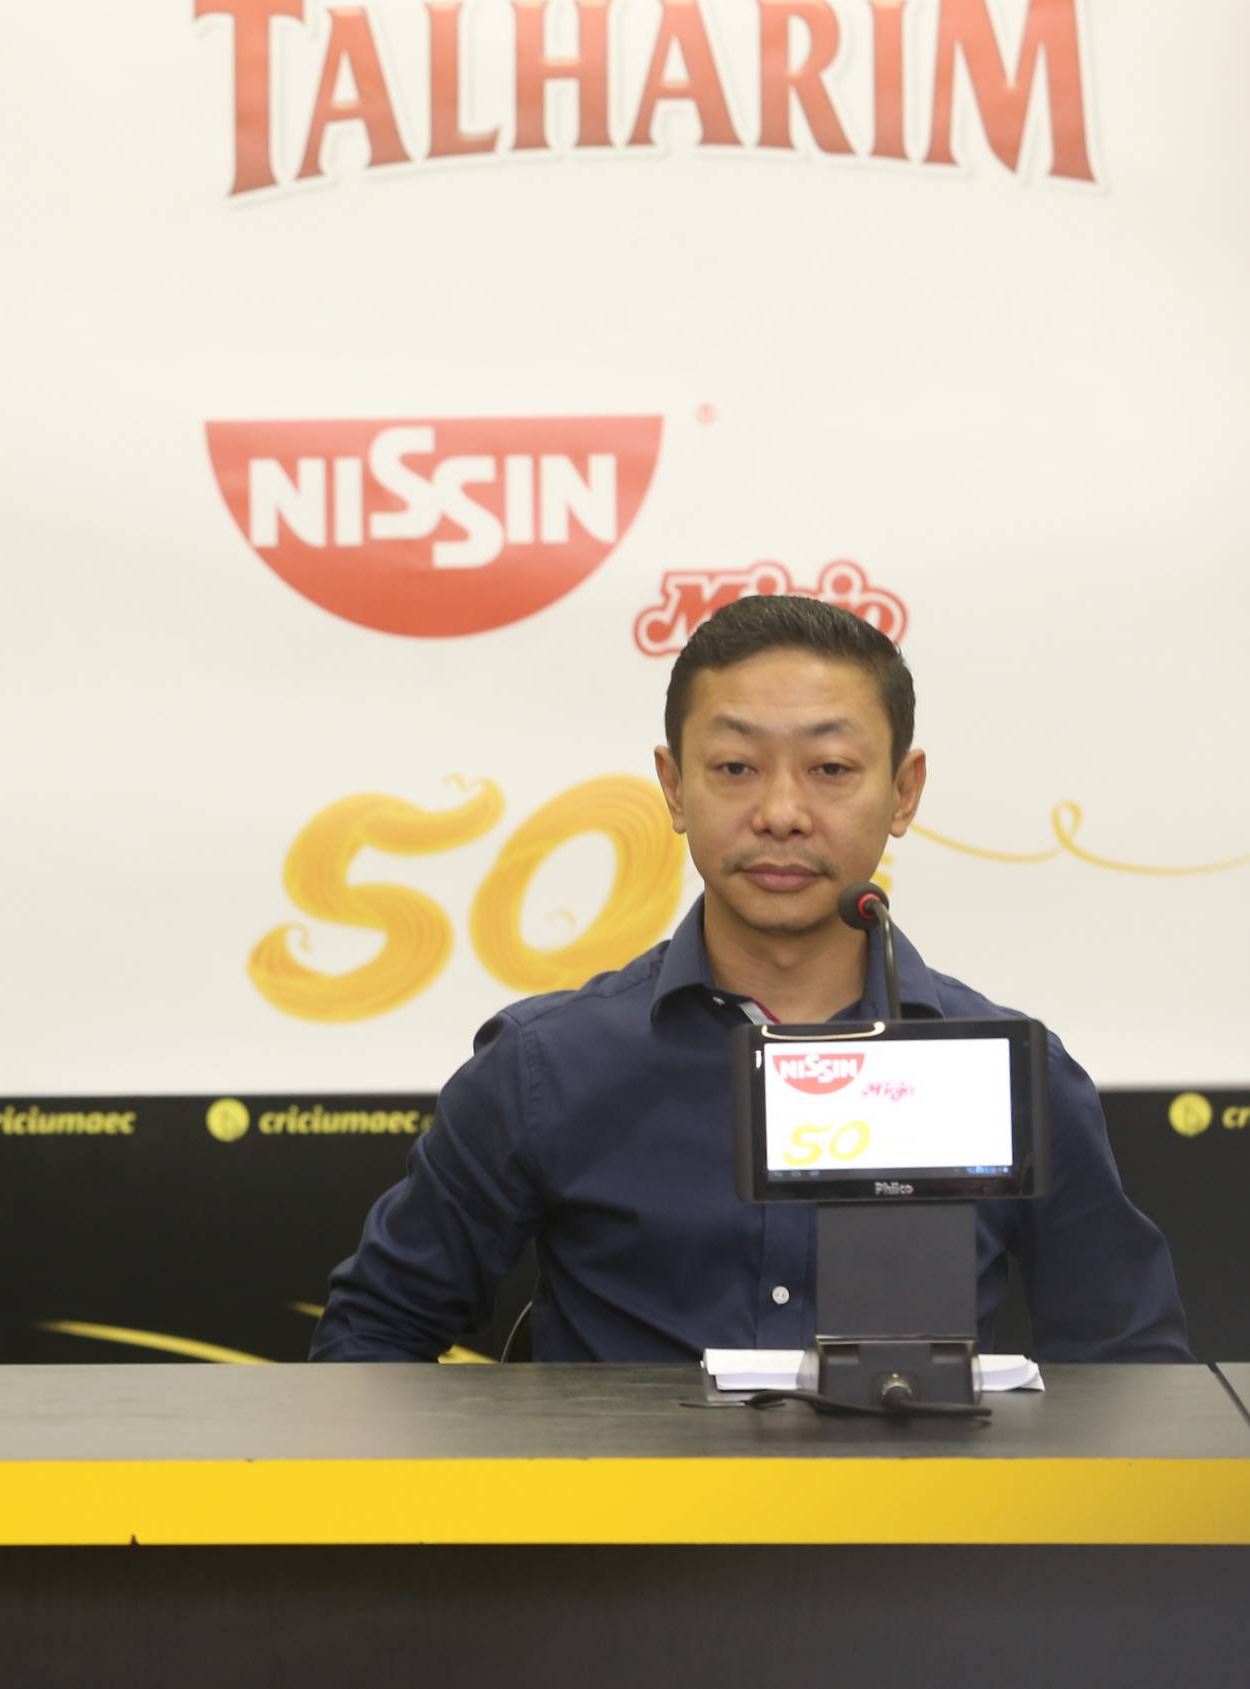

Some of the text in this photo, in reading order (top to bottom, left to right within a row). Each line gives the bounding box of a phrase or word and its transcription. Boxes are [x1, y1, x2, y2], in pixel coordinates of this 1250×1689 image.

[193, 0, 1099, 197] TALHARIM
[249, 427, 618, 569] NISSIN
[246, 773, 688, 1025] 50
[779, 1054, 859, 1083] NISSIN
[783, 1120, 871, 1167] 50
[875, 1182, 913, 1195] Philco
